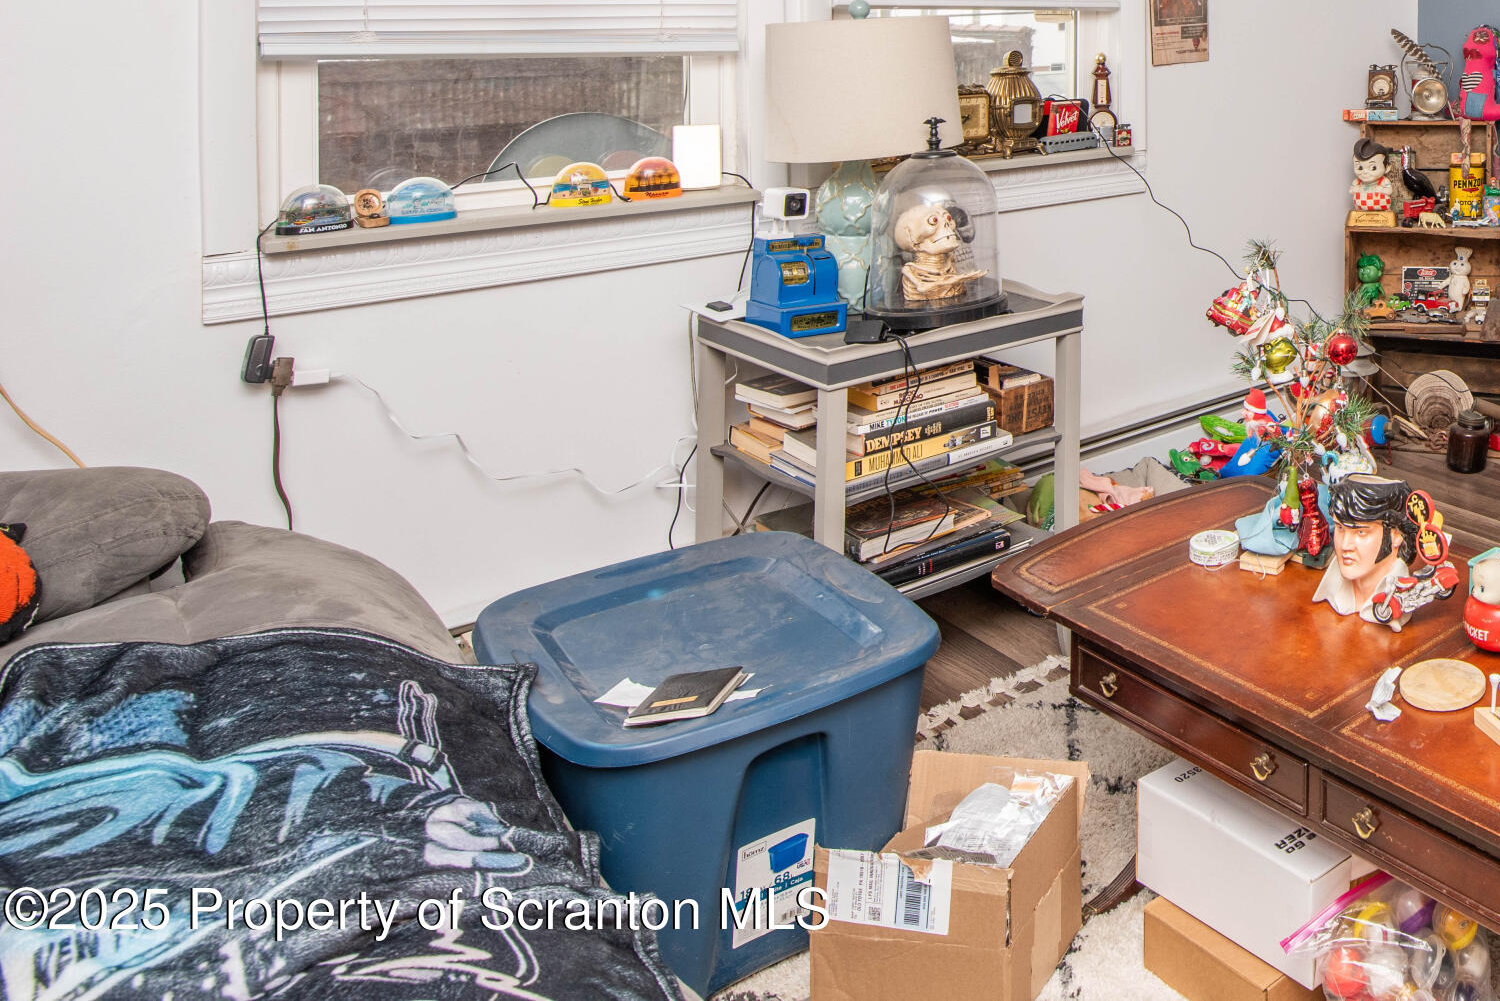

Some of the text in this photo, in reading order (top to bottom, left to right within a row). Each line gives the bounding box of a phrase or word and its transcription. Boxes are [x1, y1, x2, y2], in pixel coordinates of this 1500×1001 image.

[1056, 107, 1078, 128] Velvet
[1453, 178, 1482, 189] PENNZO
[316, 223, 348, 232] ANTONIO
[869, 420, 885, 431] MIKE
[868, 444, 923, 472] MUHAMMD ALI
[774, 871, 790, 885] 68
